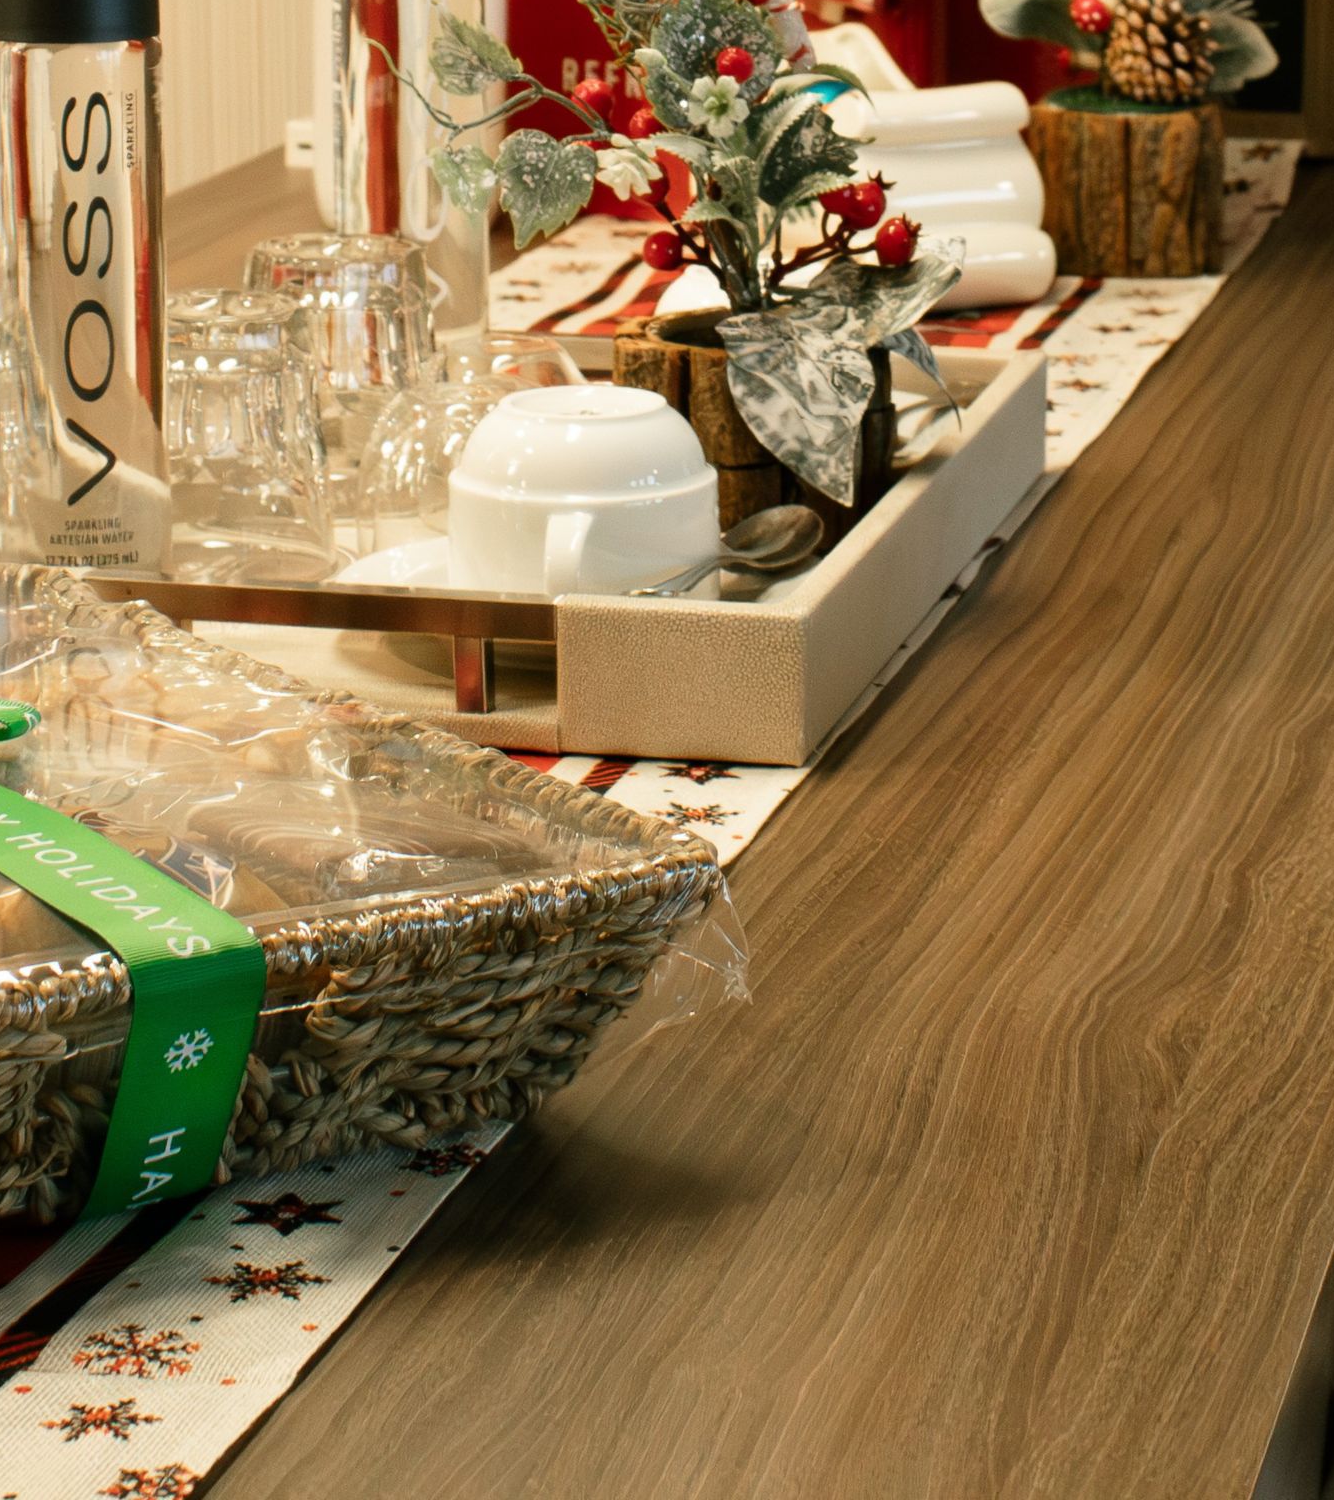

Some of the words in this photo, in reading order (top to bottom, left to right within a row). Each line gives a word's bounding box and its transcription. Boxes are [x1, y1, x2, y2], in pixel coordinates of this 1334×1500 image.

[124, 92, 135, 170] SPARKLING
[61, 91, 116, 507] VOSS
[49, 534, 99, 546] ARTESIAN
[102, 531, 134, 544] WATER
[64, 517, 121, 530] SPARKLING
[5, 831, 211, 959] HOLIDAYS
